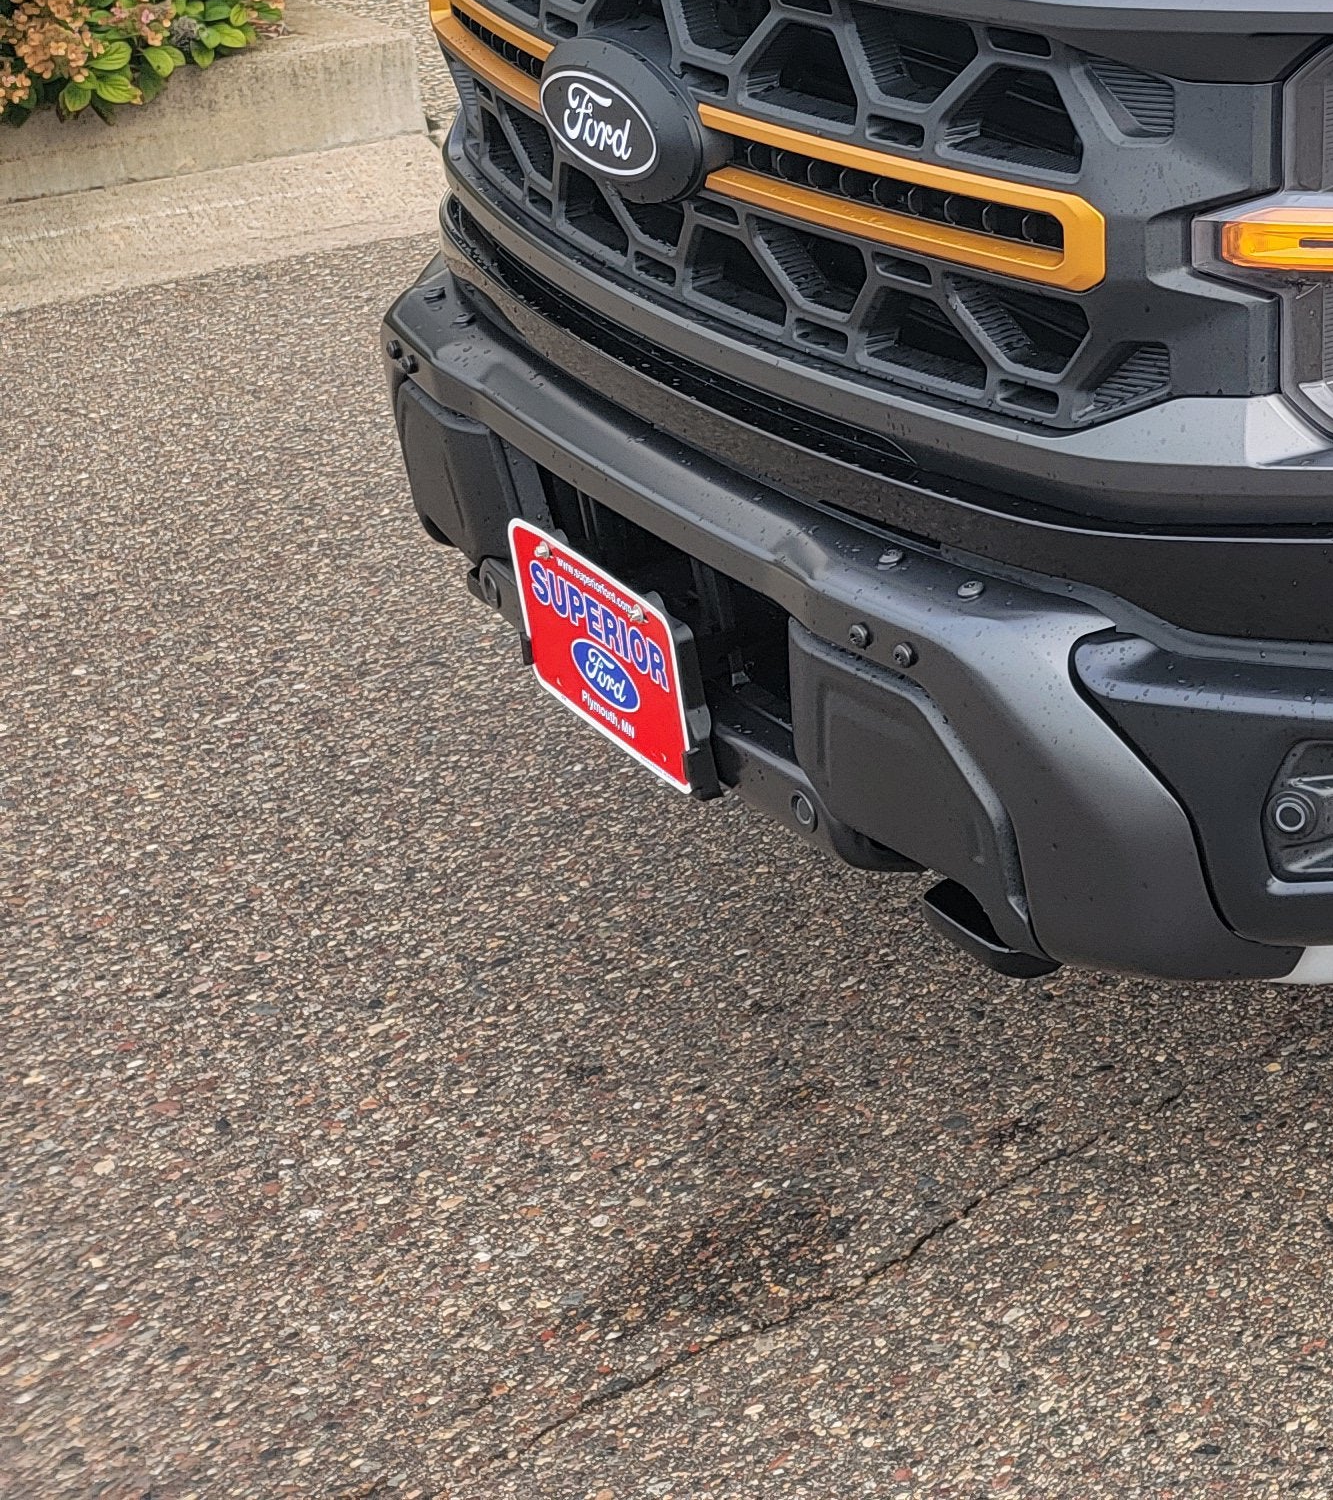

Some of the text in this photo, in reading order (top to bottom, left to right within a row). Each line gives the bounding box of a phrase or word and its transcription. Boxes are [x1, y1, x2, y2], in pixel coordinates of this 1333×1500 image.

[563, 82, 633, 161] Ford
[529, 560, 670, 693] SUPERIOR
[585, 647, 626, 704] Ford
[582, 689, 635, 739] Plymouth, MN
